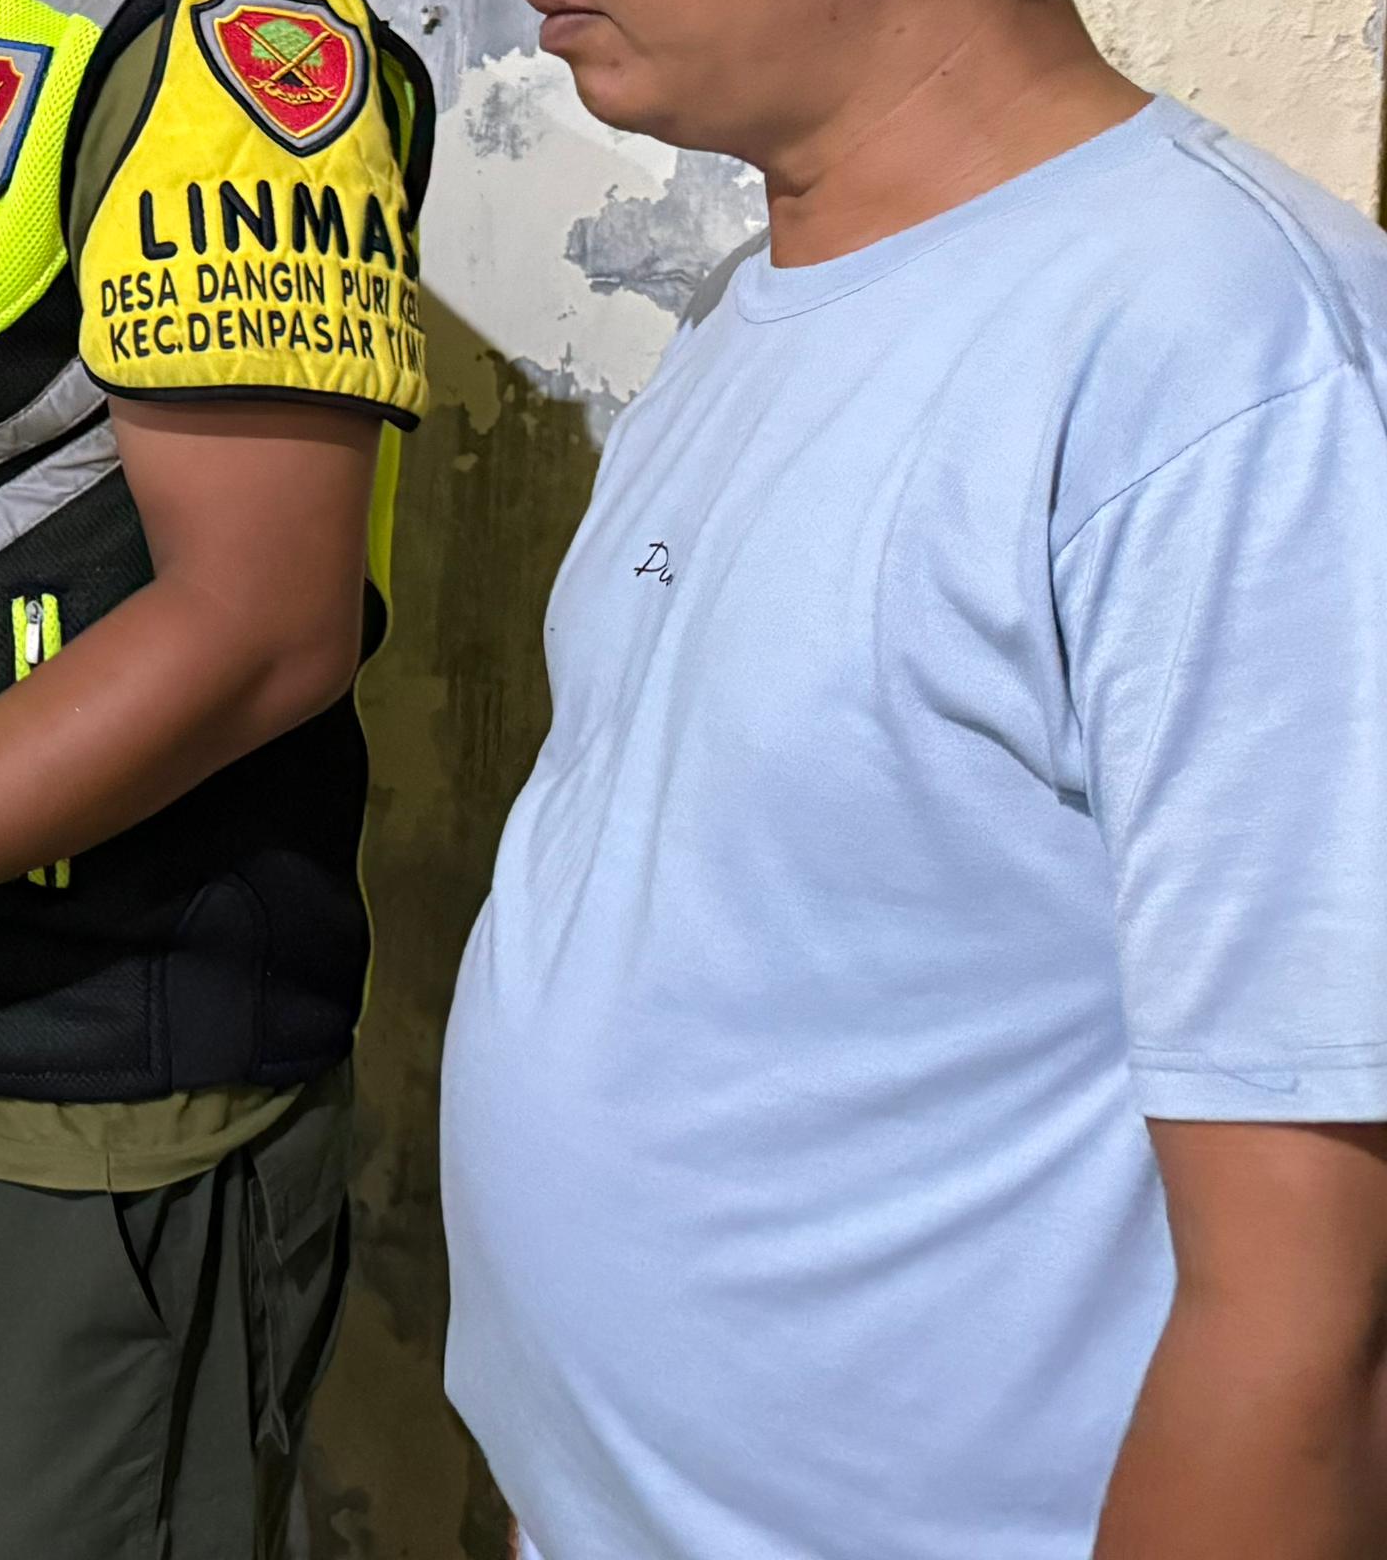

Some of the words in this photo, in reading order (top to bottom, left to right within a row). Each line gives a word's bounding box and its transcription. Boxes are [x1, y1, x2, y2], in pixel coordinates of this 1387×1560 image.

[100, 266, 180, 318] DESA
[197, 261, 327, 307] DANGIN
[341, 269, 390, 319] PURI
[109, 308, 375, 364] KEC.DENPASAR
